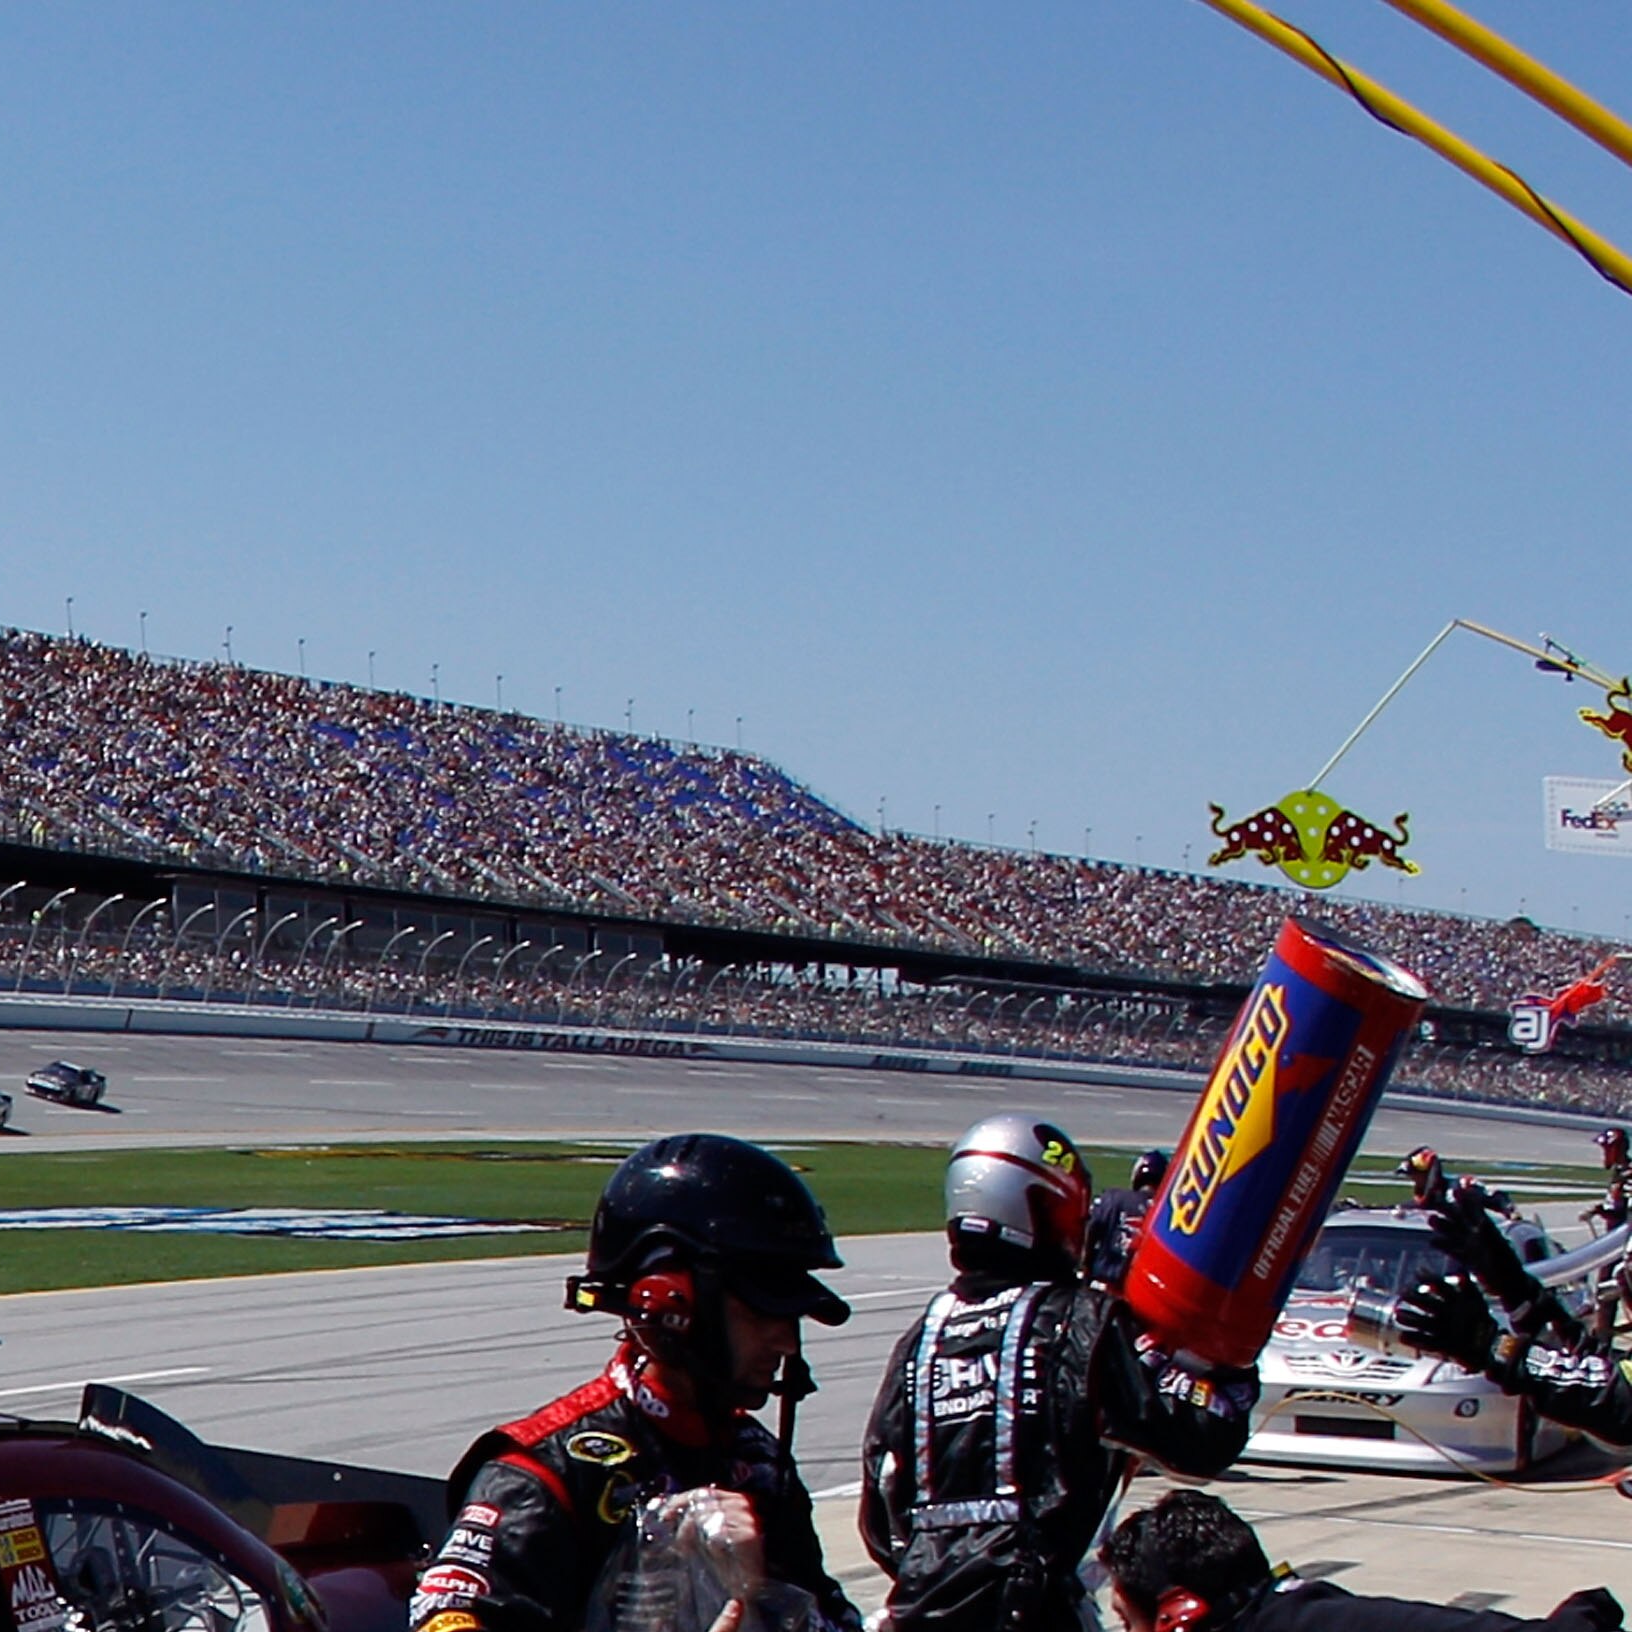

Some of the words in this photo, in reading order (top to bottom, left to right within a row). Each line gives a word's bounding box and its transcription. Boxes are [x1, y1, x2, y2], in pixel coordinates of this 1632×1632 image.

[1561, 808, 1618, 831] FedEx
[1515, 1008, 1550, 1050] aj
[1175, 992, 1288, 1226] SUNOCO
[1042, 1140, 1076, 1175] 24
[1252, 1204, 1299, 1281] OFFICIAL
[1288, 1158, 1320, 1206] FUEL
[421, 1575, 479, 1592] DELPHI
